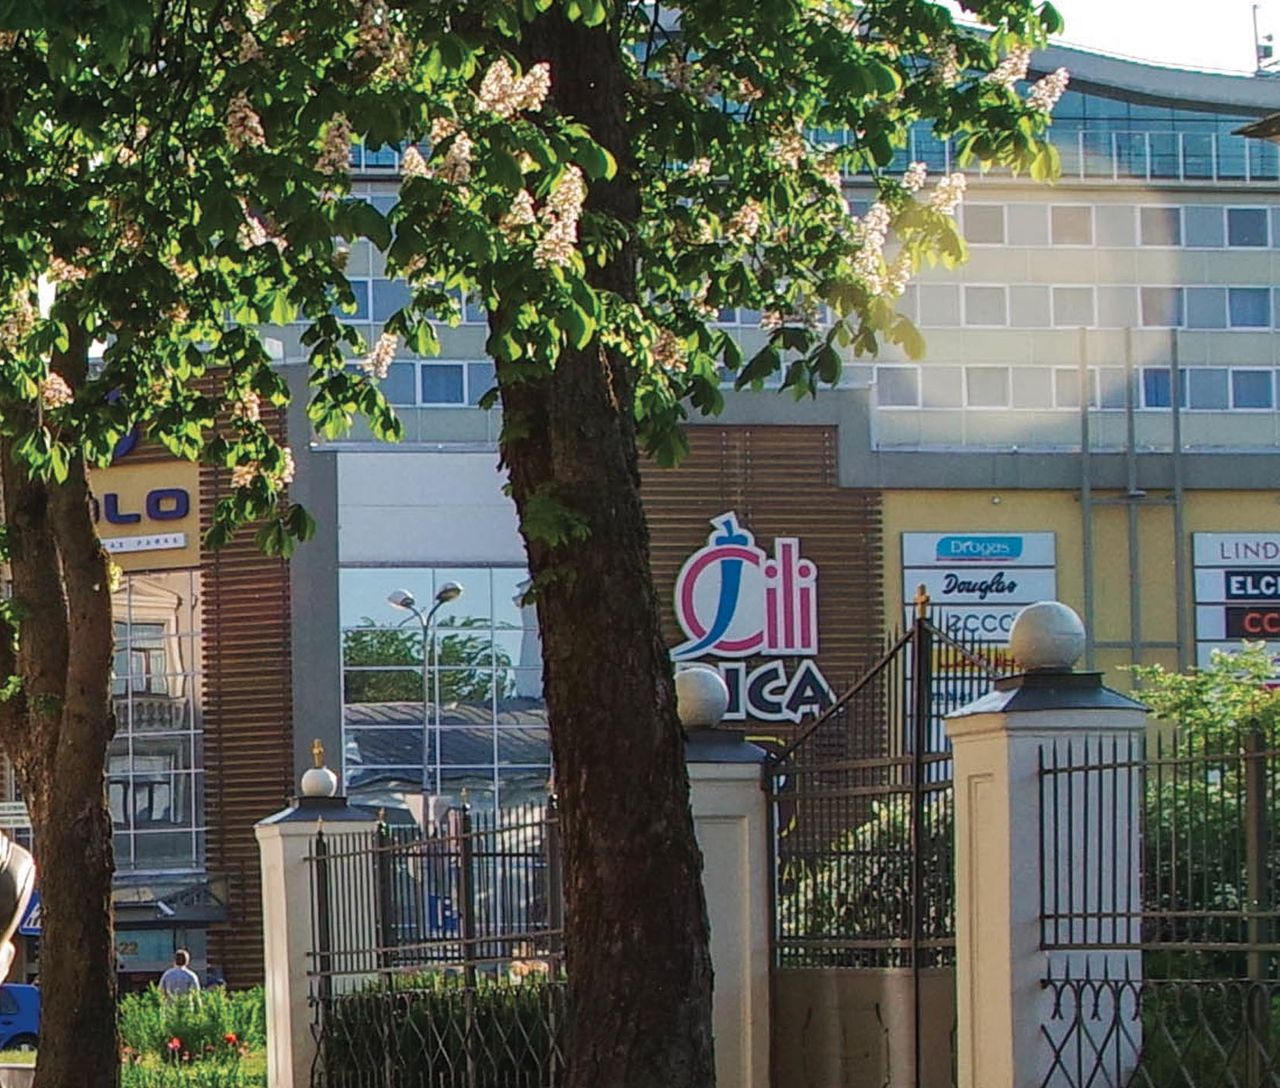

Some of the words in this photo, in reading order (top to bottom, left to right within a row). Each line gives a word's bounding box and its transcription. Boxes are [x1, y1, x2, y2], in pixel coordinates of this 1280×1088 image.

[950, 540, 1010, 558] Drogas
[942, 571, 1018, 600] Douglas
[1229, 575, 1280, 595] ELC
[724, 660, 838, 719] ICA
